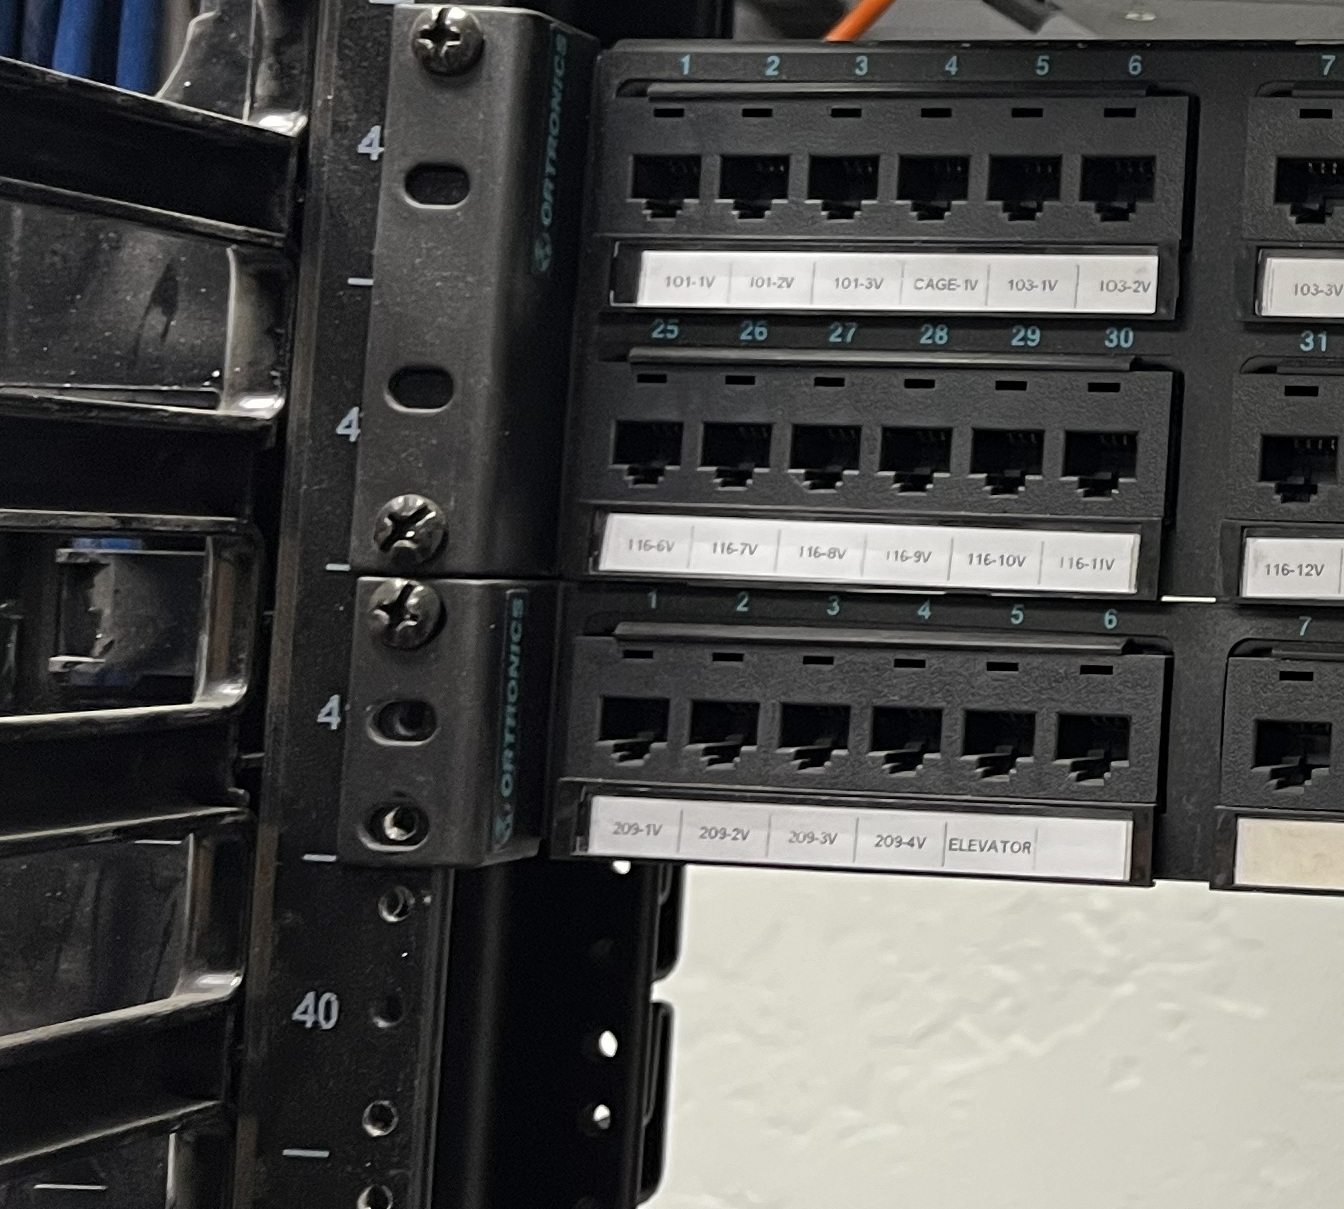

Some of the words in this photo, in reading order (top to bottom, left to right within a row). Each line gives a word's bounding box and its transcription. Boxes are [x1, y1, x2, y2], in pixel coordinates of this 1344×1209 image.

[680, 54, 691, 76] 1
[764, 55, 781, 76] 2
[854, 55, 869, 76] 3
[944, 55, 959, 76] 4
[1035, 54, 1050, 76] 5
[1128, 54, 1143, 76] 6
[1321, 54, 1336, 76] 7
[357, 125, 385, 161] 4
[541, 34, 568, 226] ORTRONICS
[664, 275, 716, 289] 101-1V
[834, 276, 885, 290] 101-3V
[913, 277, 979, 292] CAGE-1V
[1007, 278, 1059, 292] 103-1V
[1099, 279, 1152, 294] 103-2V
[1294, 282, 1344, 297] 103-3V
[651, 321, 680, 341] 25
[739, 322, 768, 342] 26
[828, 324, 856, 344] 27
[919, 325, 949, 346] 28
[1010, 327, 1041, 347] 29
[1104, 328, 1134, 349] 30
[1299, 332, 1327, 352] 31
[336, 406, 361, 442] 4
[712, 541, 759, 556] 116-7V
[886, 549, 933, 564] 116-9V
[968, 552, 1027, 568] 116-10V
[1059, 556, 1116, 571] 116-11V
[1265, 562, 1325, 577] 116-12V
[647, 590, 657, 610] 1
[735, 595, 749, 612] 2
[826, 599, 840, 616] 3
[916, 602, 932, 620] 4
[1010, 606, 1024, 625] 5
[1103, 610, 1118, 630] 6
[1299, 616, 1312, 637] 7
[317, 694, 342, 730] 4
[611, 821, 663, 837] 209-1V
[698, 825, 751, 842] 209-2V
[787, 829, 839, 846] 209-3V
[874, 834, 928, 850] 209-4V
[948, 837, 1032, 855] ELEVATOR
[292, 991, 340, 1031] 40
